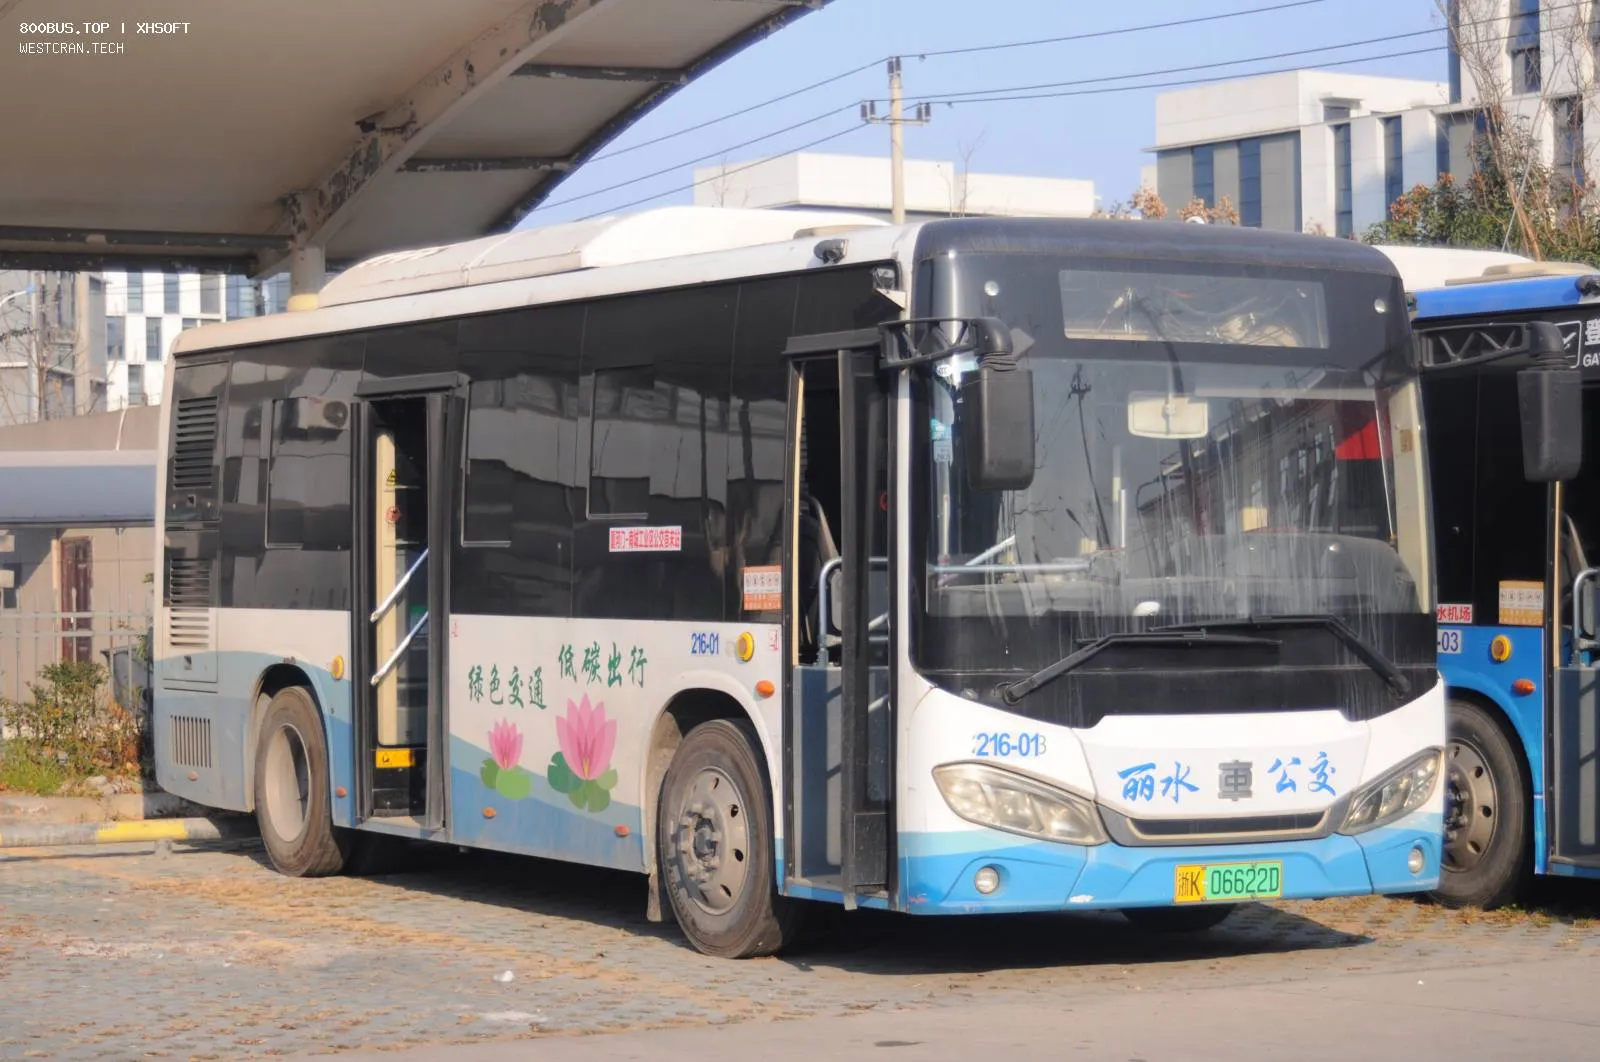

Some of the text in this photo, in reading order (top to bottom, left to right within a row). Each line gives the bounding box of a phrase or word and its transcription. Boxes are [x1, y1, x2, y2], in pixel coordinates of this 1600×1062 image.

[1582, 352, 1600, 367] GA
[691, 632, 719, 654] 216-01
[558, 640, 648, 688] 低碳出行
[468, 663, 547, 710] 绿色交通
[976, 732, 1039, 756] 216-01
[1117, 760, 1200, 804] 丽水
[1267, 751, 1337, 796] 公交
[1177, 867, 1279, 896] 浙K 06622D
